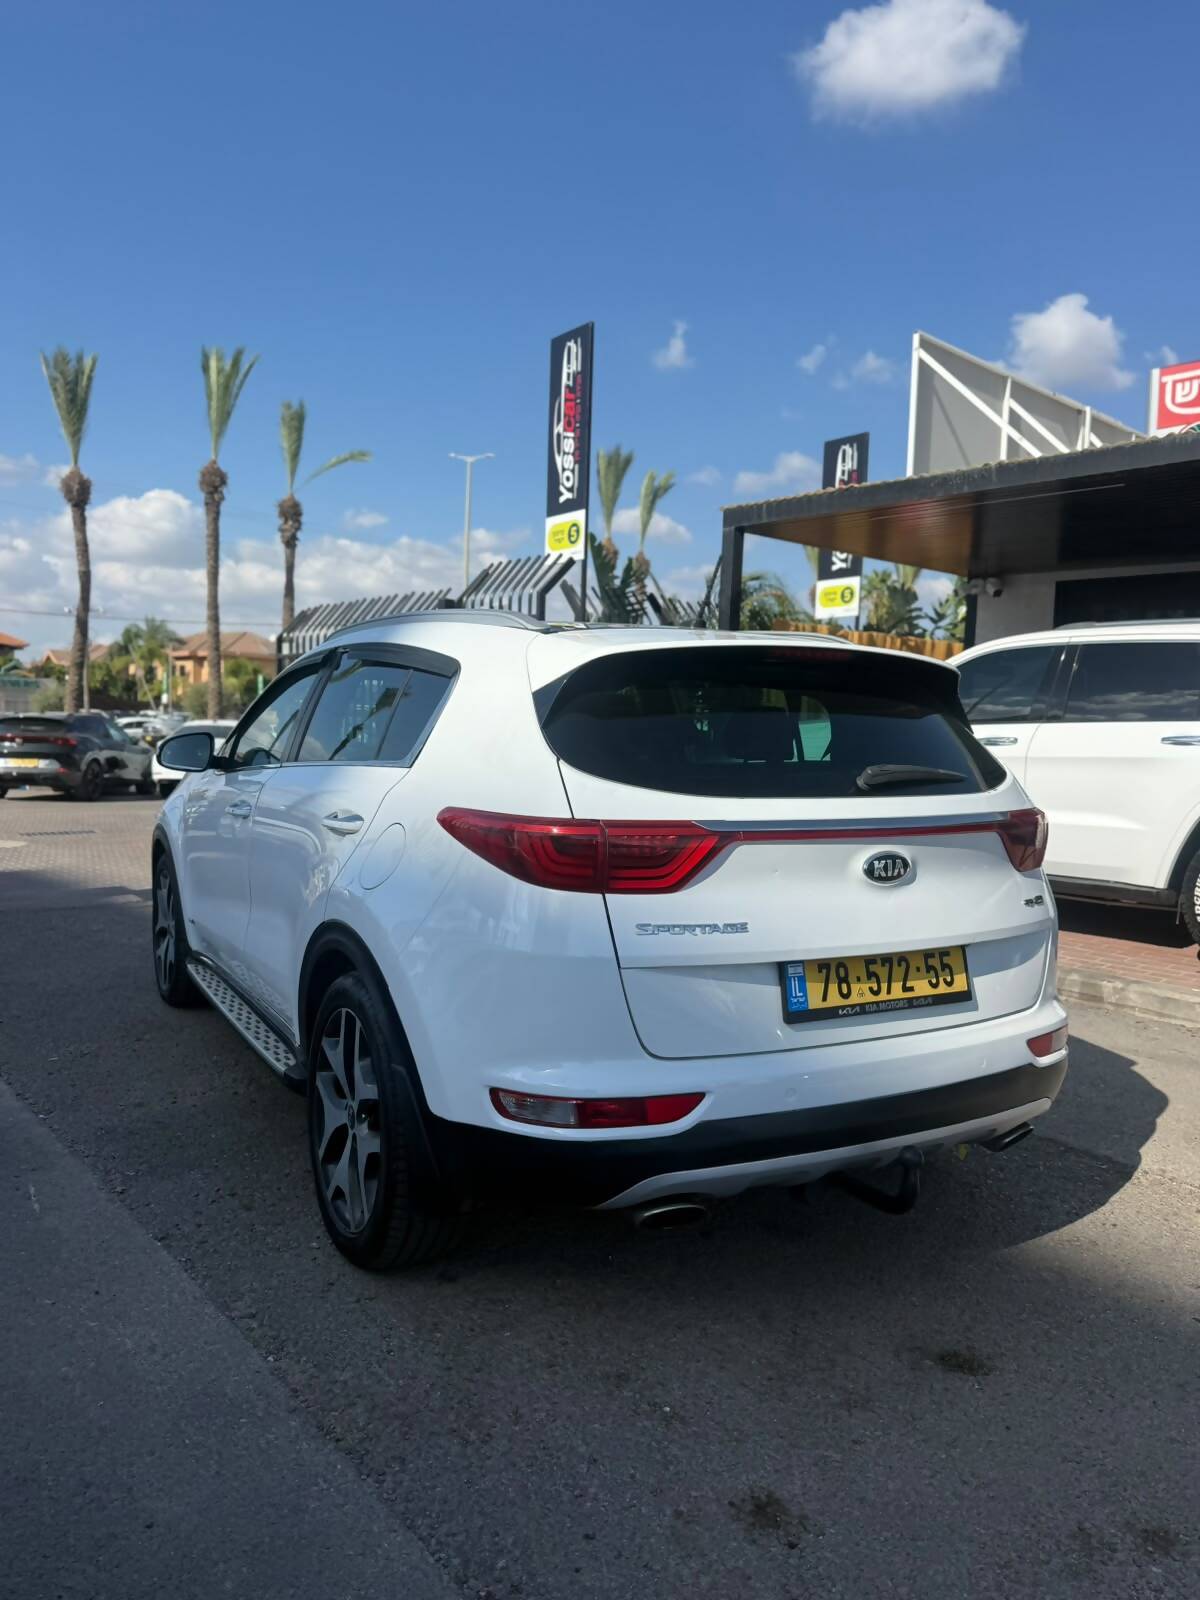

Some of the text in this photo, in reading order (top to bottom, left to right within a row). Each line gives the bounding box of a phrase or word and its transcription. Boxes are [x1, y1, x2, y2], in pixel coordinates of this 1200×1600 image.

[873, 860, 905, 877] KIA
[635, 922, 749, 936] SPORTAGE
[791, 976, 803, 997] IL
[879, 999, 909, 1010] MOTORS
